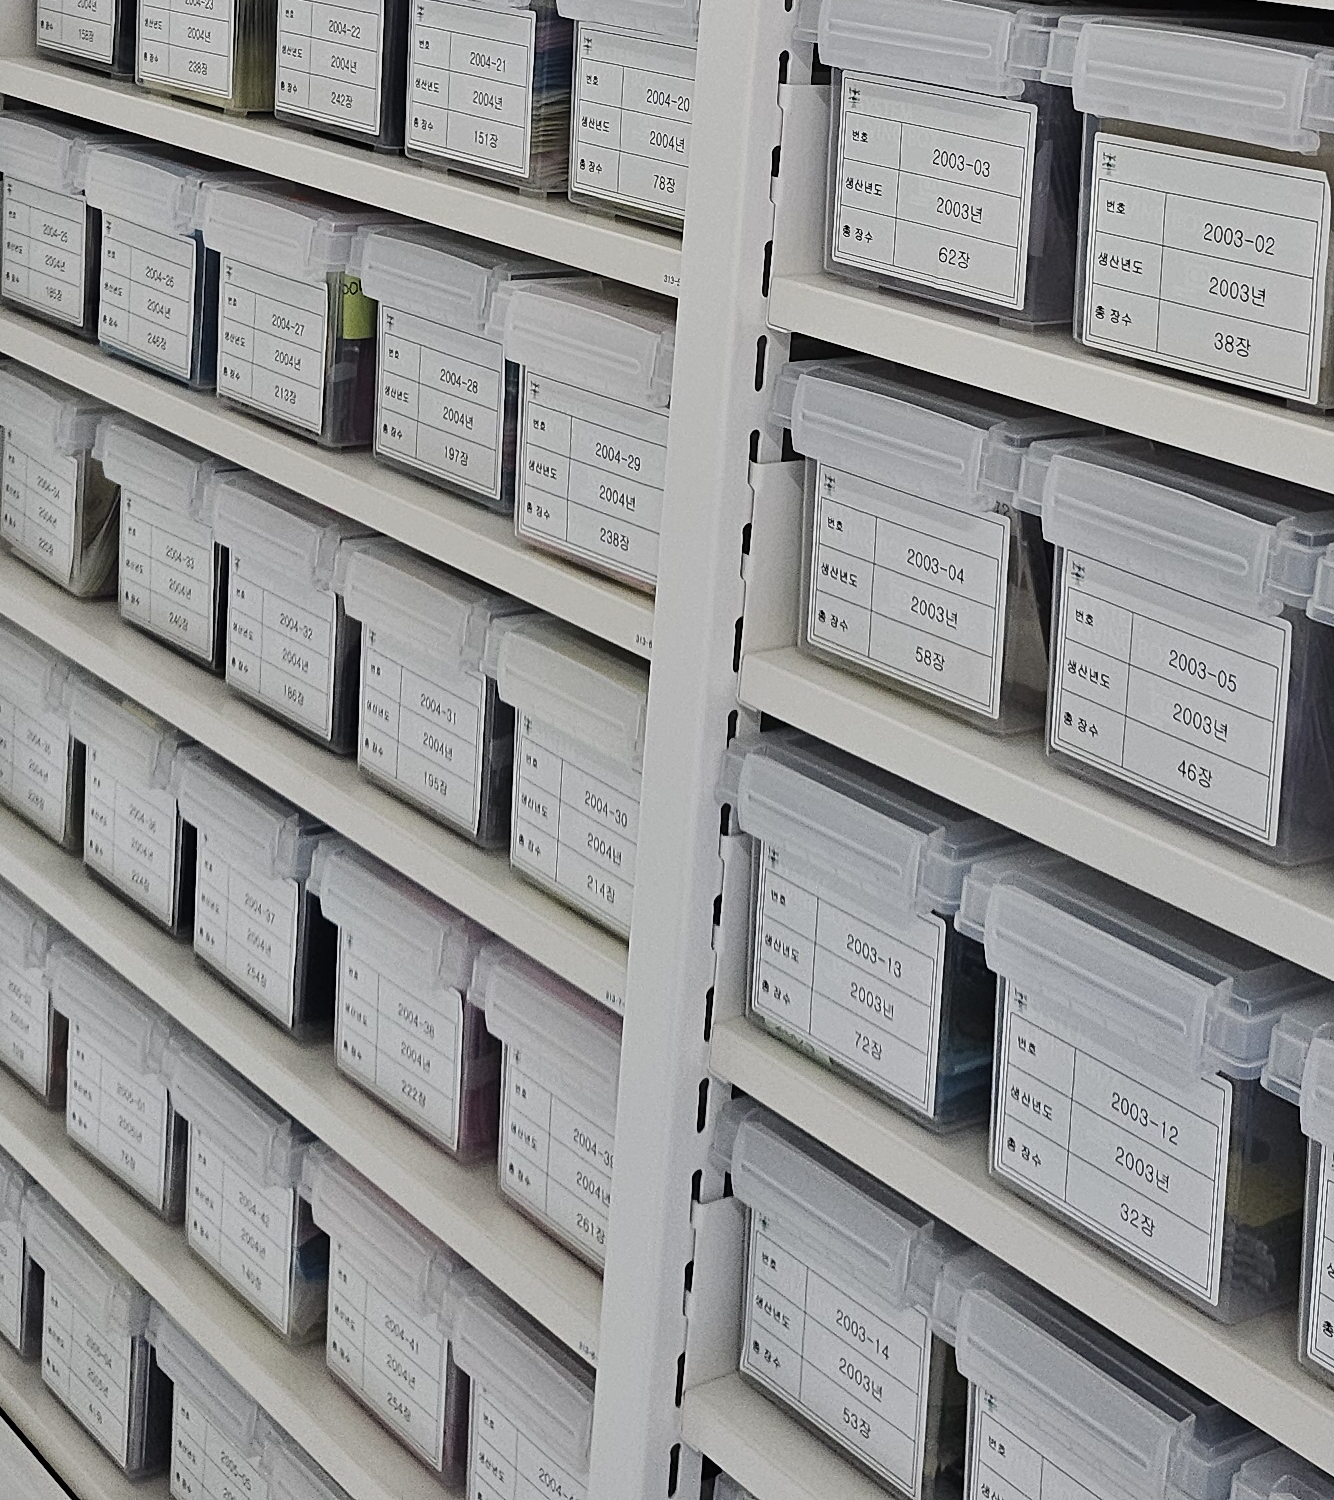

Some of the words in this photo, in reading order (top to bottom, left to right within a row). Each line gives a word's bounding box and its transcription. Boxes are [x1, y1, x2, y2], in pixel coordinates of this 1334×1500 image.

[469, 51, 506, 73] 2004-21
[646, 88, 690, 112] 2004-20
[474, 130, 498, 149] 151장
[932, 148, 990, 178] 2003-03
[653, 174, 676, 194] 78장
[1203, 222, 1275, 256] 2003-02
[938, 247, 970, 269] 62장
[1209, 276, 1266, 308] 2003년
[1214, 332, 1251, 358] 38장
[439, 368, 478, 394] 2004-28
[595, 442, 641, 472] 2004-29
[599, 484, 636, 512] 2004년
[600, 527, 630, 552] 238장
[906, 548, 965, 585] 2003-04
[915, 646, 945, 672] 58장
[1169, 649, 1237, 692] 2003-05
[1177, 760, 1213, 788] 46장
[846, 933, 901, 978] 2003-13
[855, 1030, 882, 1061] 72장
[1111, 1091, 1179, 1146] 2003-12
[1120, 1203, 1155, 1238] 32장
[836, 1309, 889, 1360] 2003-14
[843, 1407, 871, 1439] 53장
